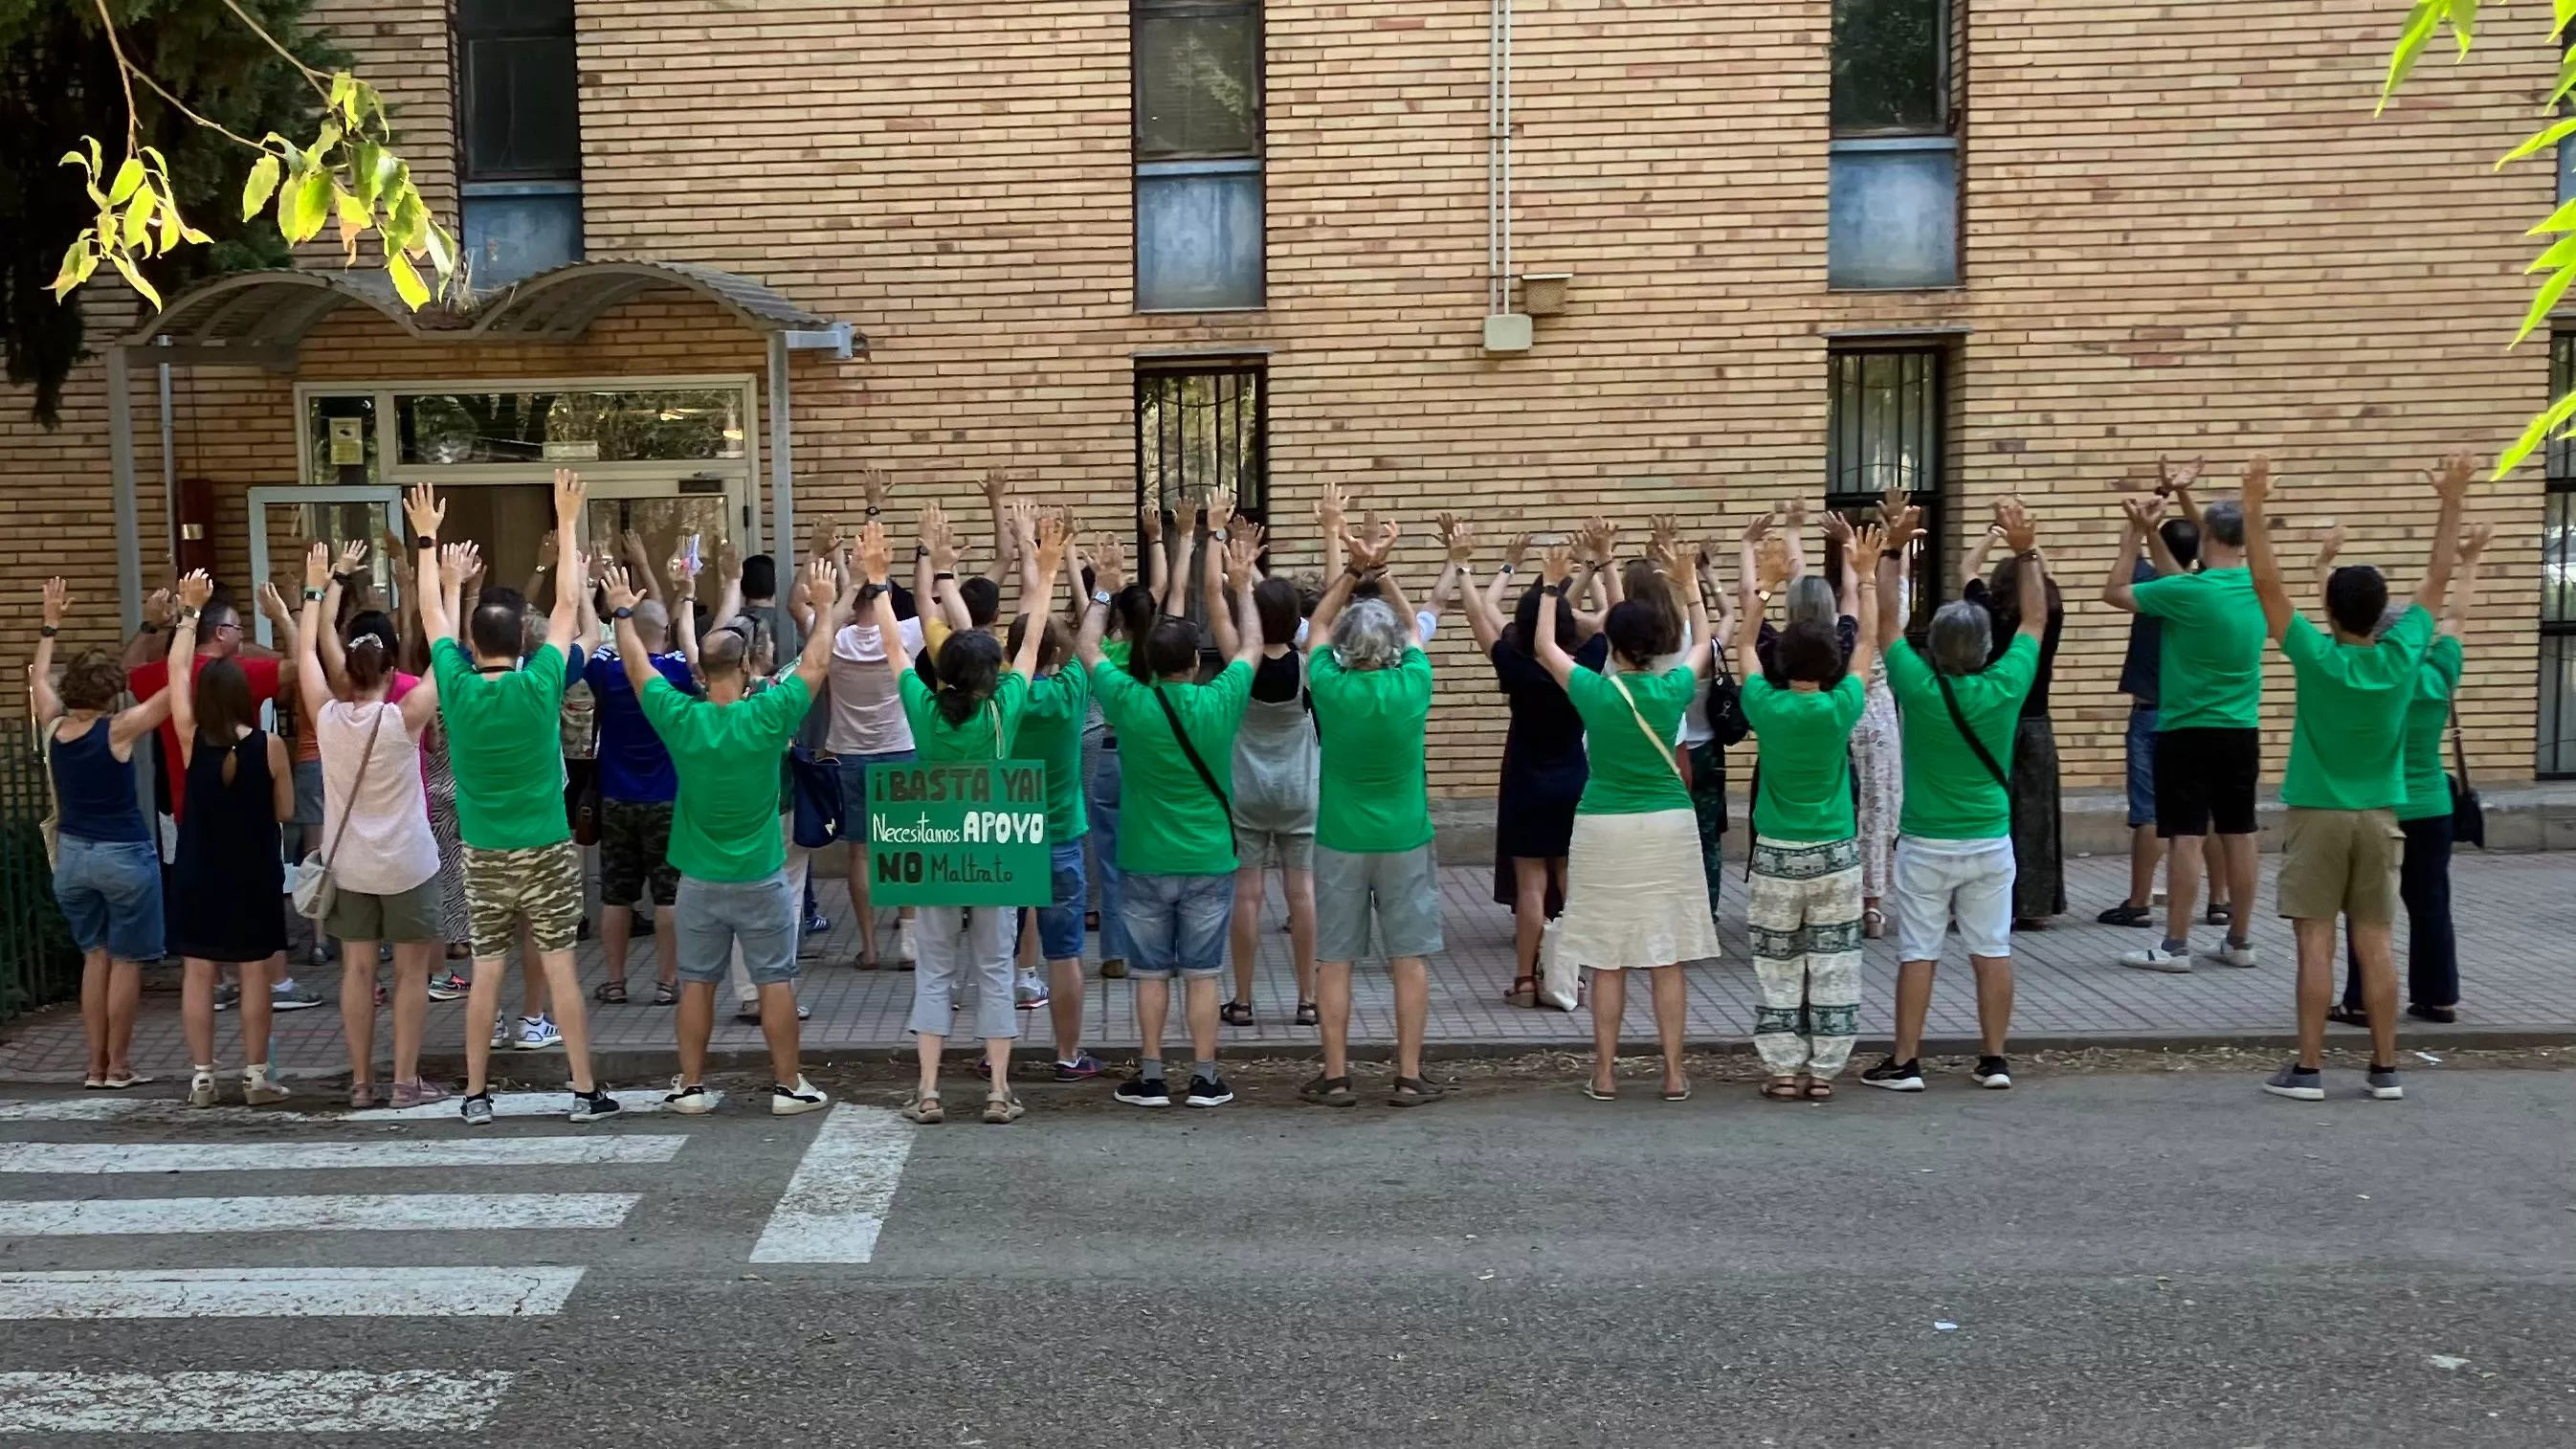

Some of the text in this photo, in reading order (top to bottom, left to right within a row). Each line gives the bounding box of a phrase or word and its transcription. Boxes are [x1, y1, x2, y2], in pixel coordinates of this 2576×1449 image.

[876, 767, 1043, 802] ¡BASTA YA!
[873, 812, 1044, 843] Necesitamos APOYO
[877, 851, 1012, 883] NO Maltrato
